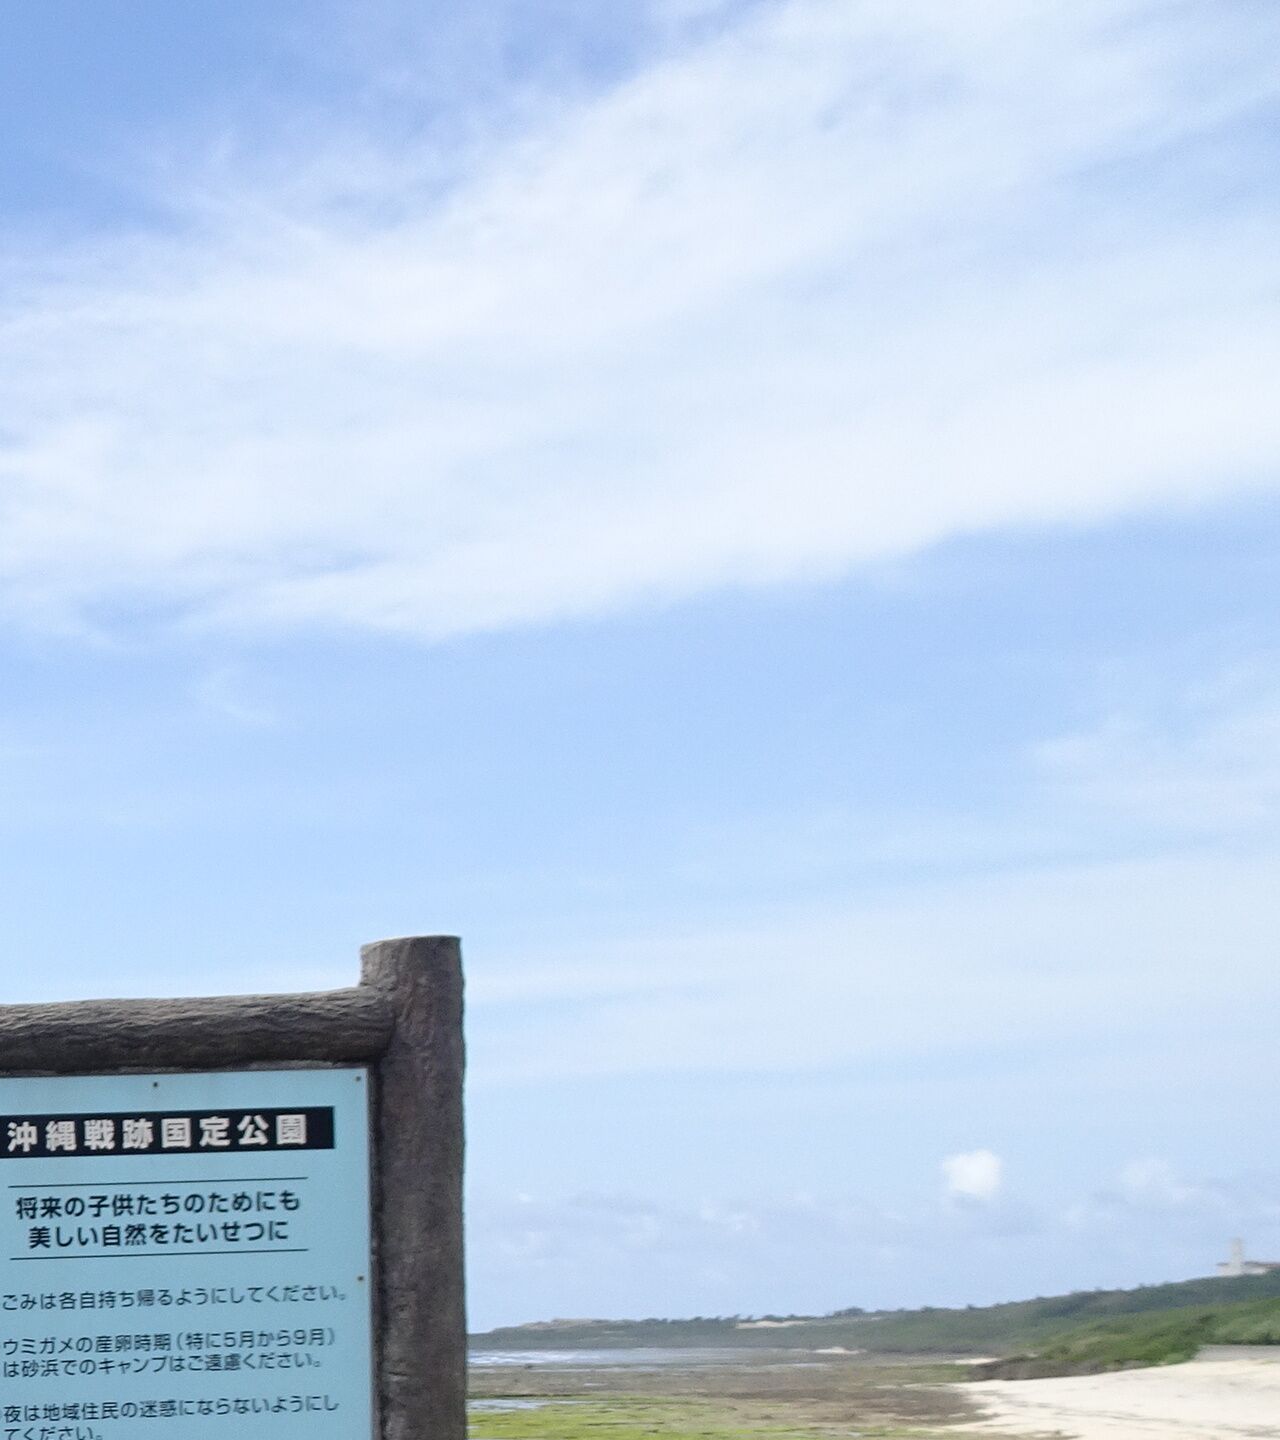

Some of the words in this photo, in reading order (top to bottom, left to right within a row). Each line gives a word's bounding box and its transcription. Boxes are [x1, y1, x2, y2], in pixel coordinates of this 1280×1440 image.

[7, 1114, 308, 1152] 沖縄戦跡国定公園
[16, 1190, 301, 1221] 将来の子供たちのためにも
[29, 1220, 289, 1249] 美しい自然をたいせつに
[3, 1352, 322, 1378] は砂浜でのキャンプはご遠慮ください。
